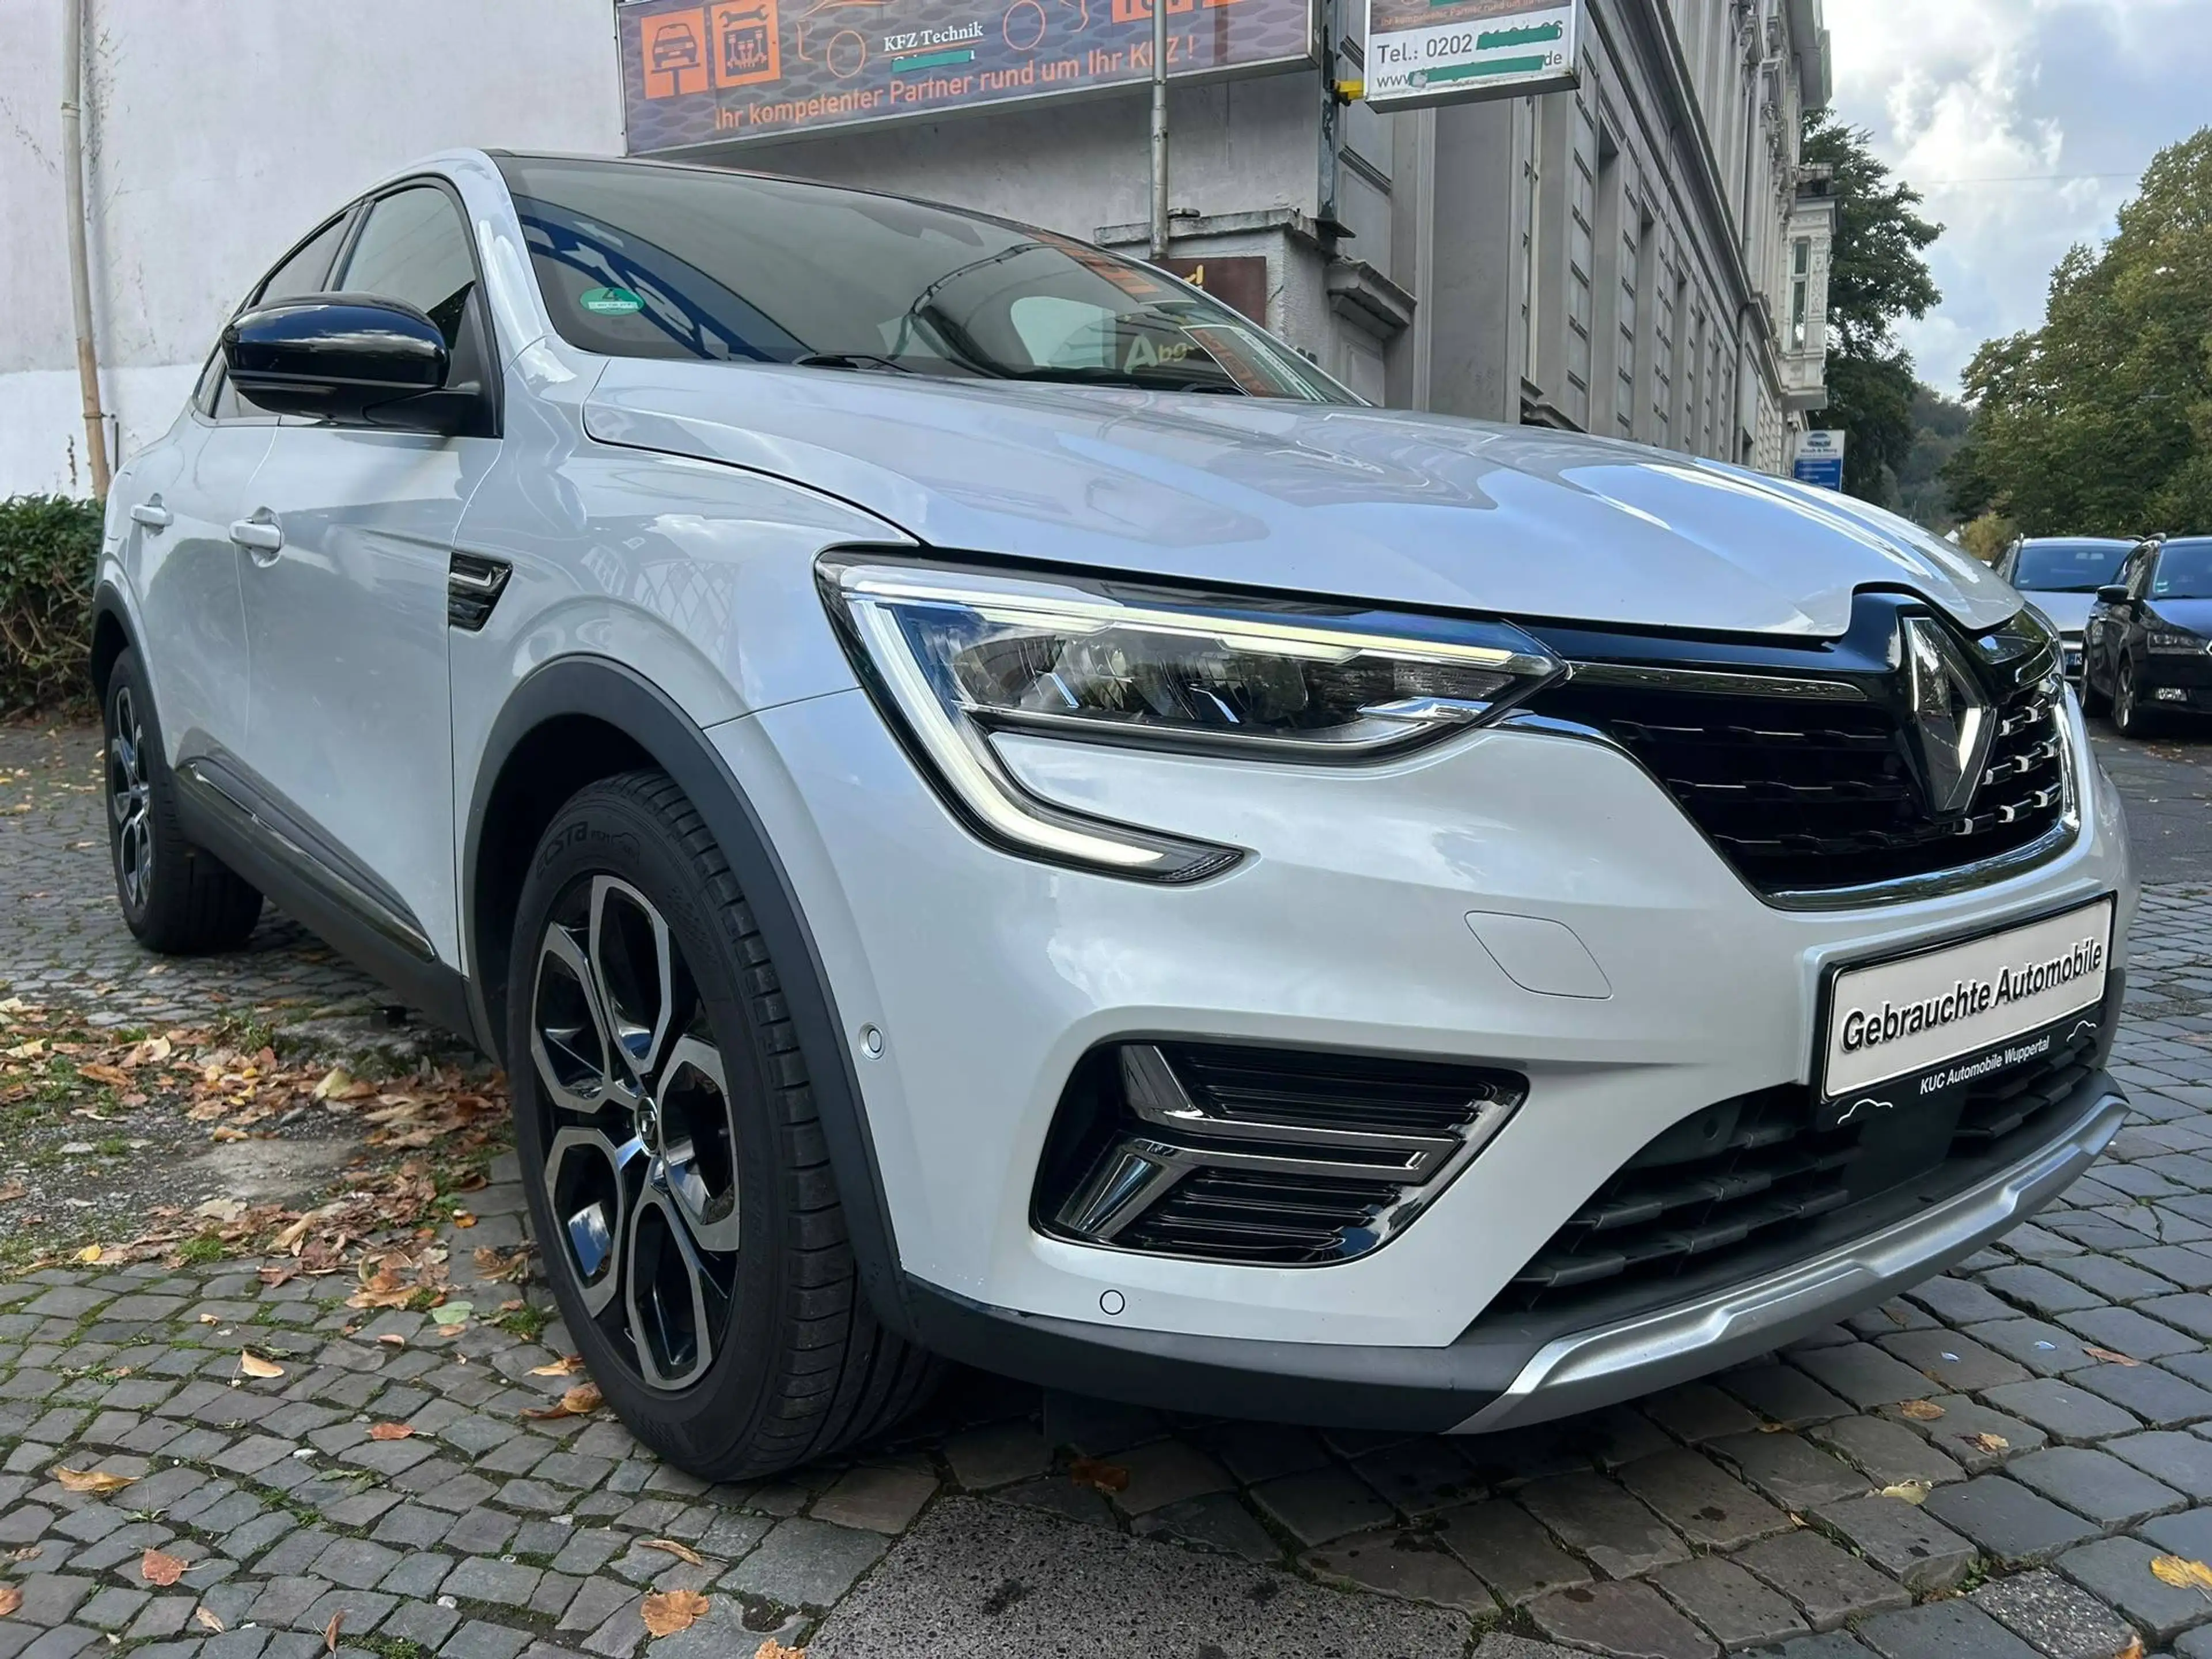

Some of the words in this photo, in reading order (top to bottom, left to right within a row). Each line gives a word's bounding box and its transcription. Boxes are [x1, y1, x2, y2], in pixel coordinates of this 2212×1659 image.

[884, 32, 918, 52] KFZ
[921, 21, 984, 46] Technik
[1377, 44, 1418, 65] Tel.:
[1426, 33, 1473, 58] 0202
[715, 107, 743, 130] Ihr
[749, 87, 884, 124] kompetenter
[889, 75, 973, 104] Partner
[980, 59, 1033, 91] rund
[1041, 56, 1080, 82] um
[1088, 48, 1123, 75] Ihr
[1843, 982, 1990, 1052] Gebrauchte
[1993, 937, 2103, 1007] Automobile
[1920, 1075, 1946, 1094] KUC
[1946, 1054, 2003, 1085] Automobile
[2004, 1036, 2050, 1065] Wuppertal
